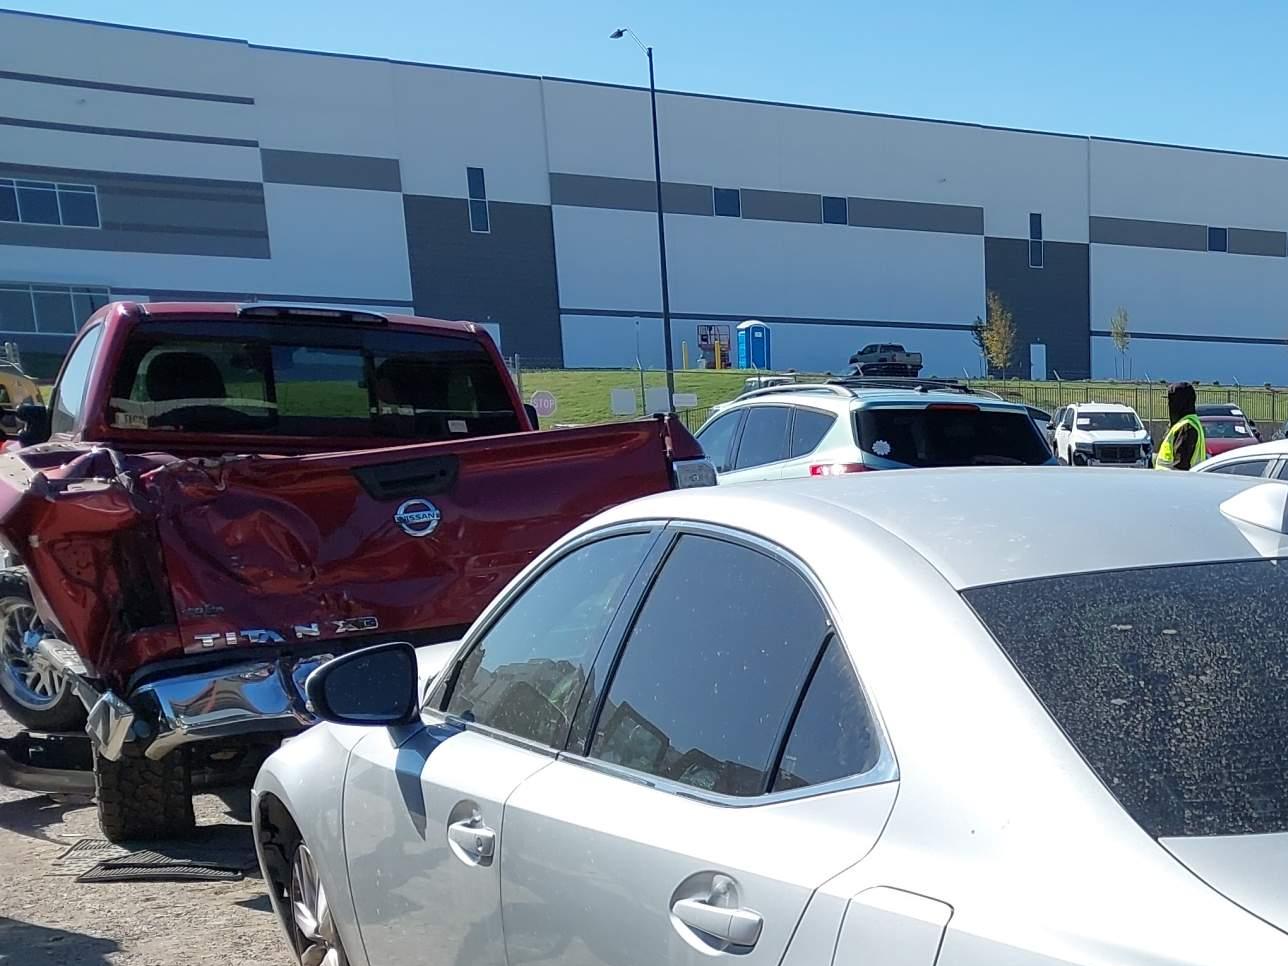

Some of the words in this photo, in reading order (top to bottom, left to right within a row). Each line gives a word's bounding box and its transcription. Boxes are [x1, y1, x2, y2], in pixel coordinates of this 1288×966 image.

[534, 399, 554, 410] STOP
[396, 511, 437, 522] NISSAN
[193, 622, 321, 648] TITAN
